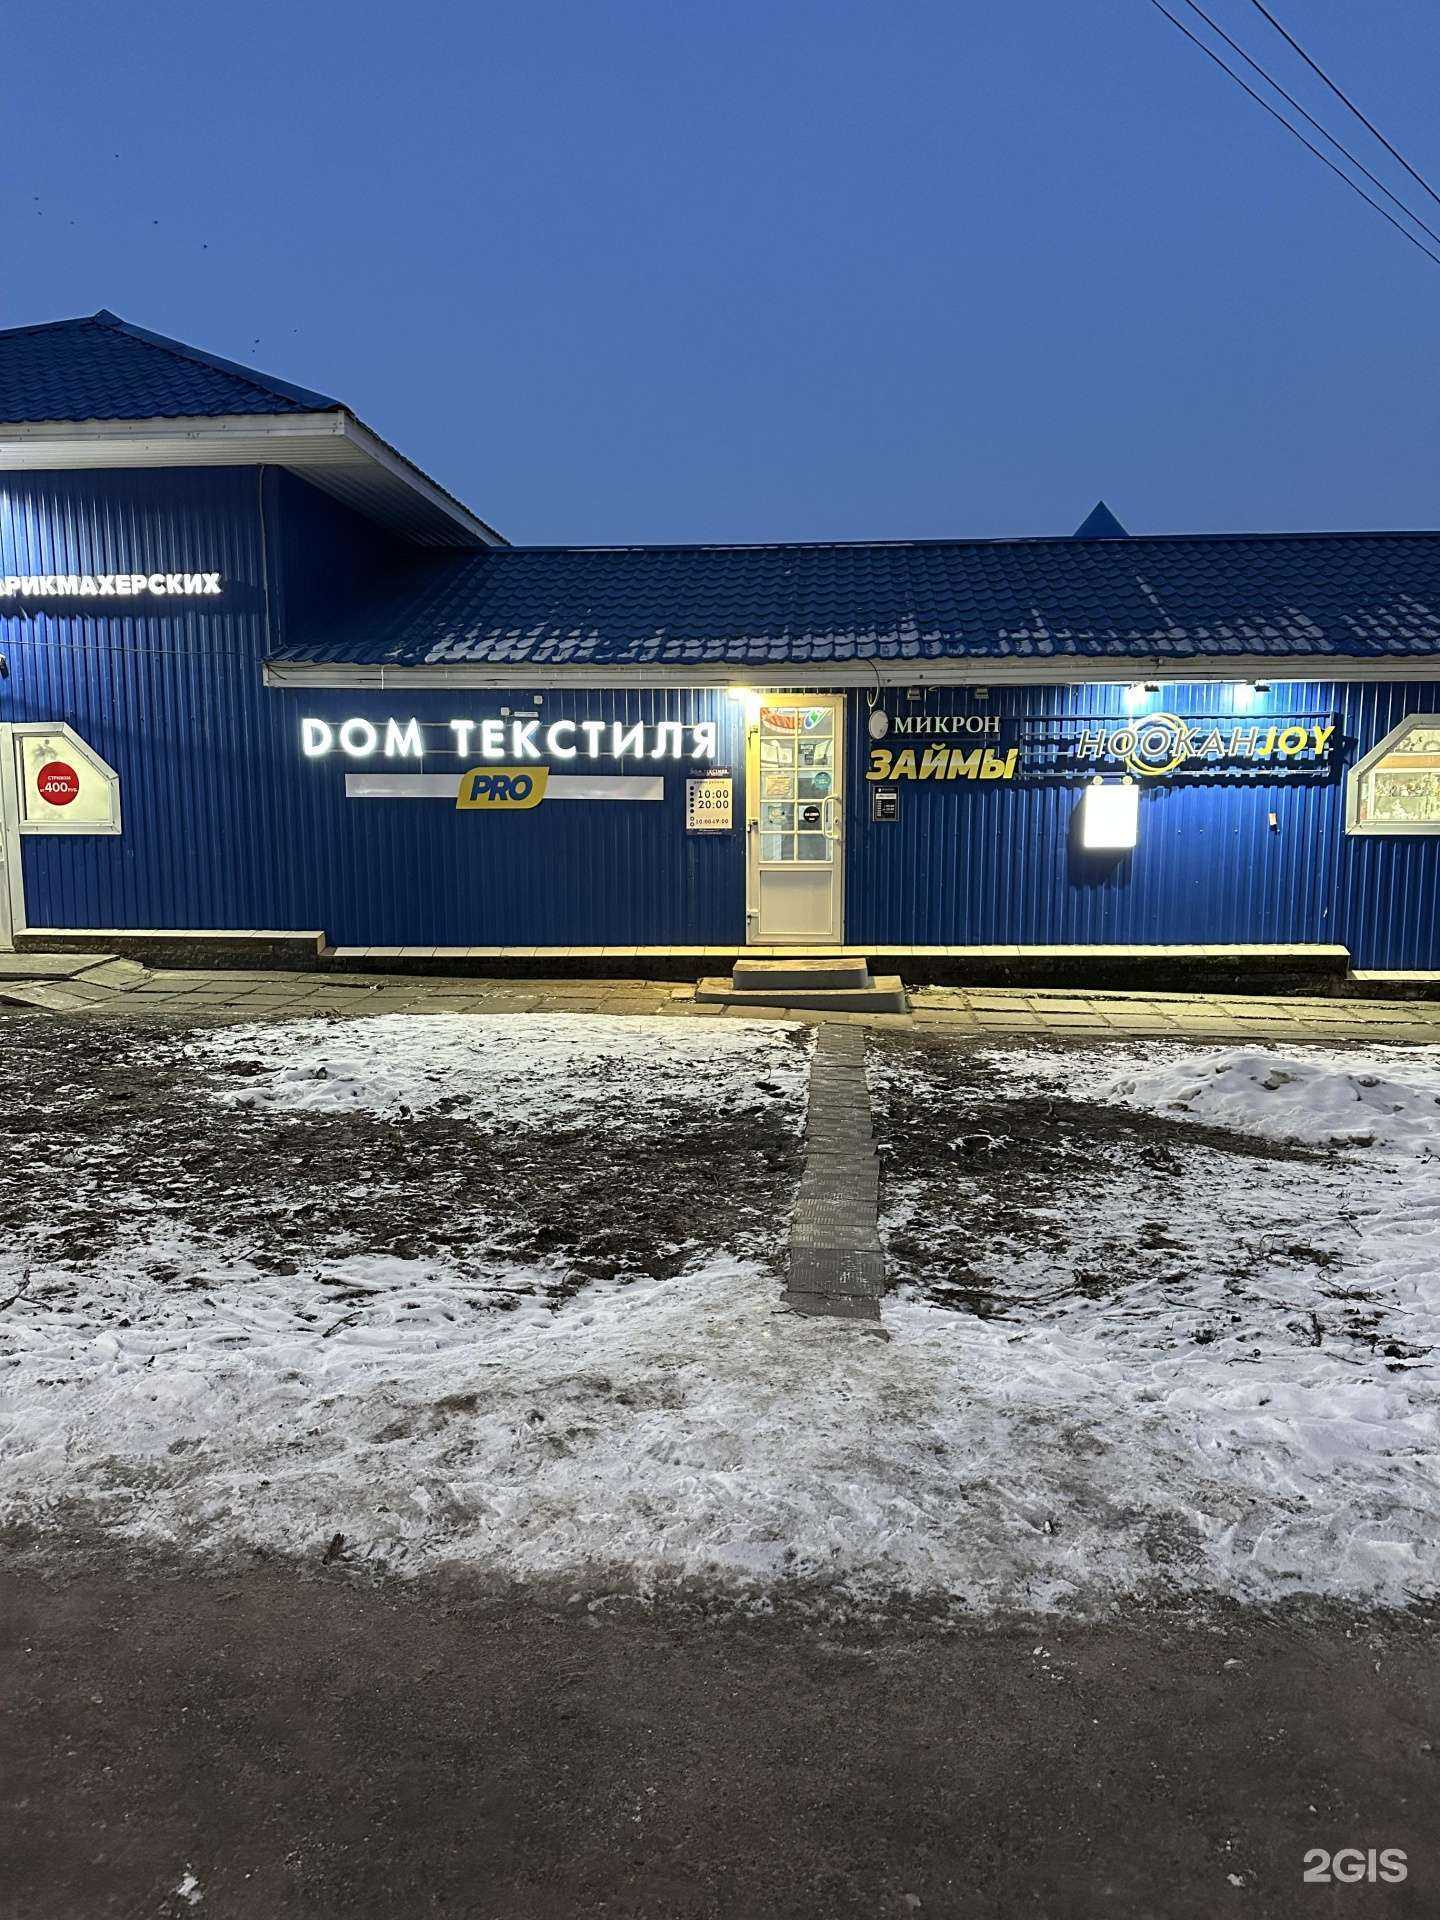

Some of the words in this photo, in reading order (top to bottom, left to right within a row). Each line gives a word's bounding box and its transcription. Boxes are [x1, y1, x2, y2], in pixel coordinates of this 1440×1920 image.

[894, 716, 1000, 733] МИКРОН
[451, 720, 717, 759] ТЕКСТИЛЯ
[865, 742, 1019, 780] ЗАЙМЫ
[44, 782, 68, 793] 400
[470, 774, 533, 802] PRO
[698, 789, 729, 799] 10:00
[698, 800, 729, 809] 20:00
